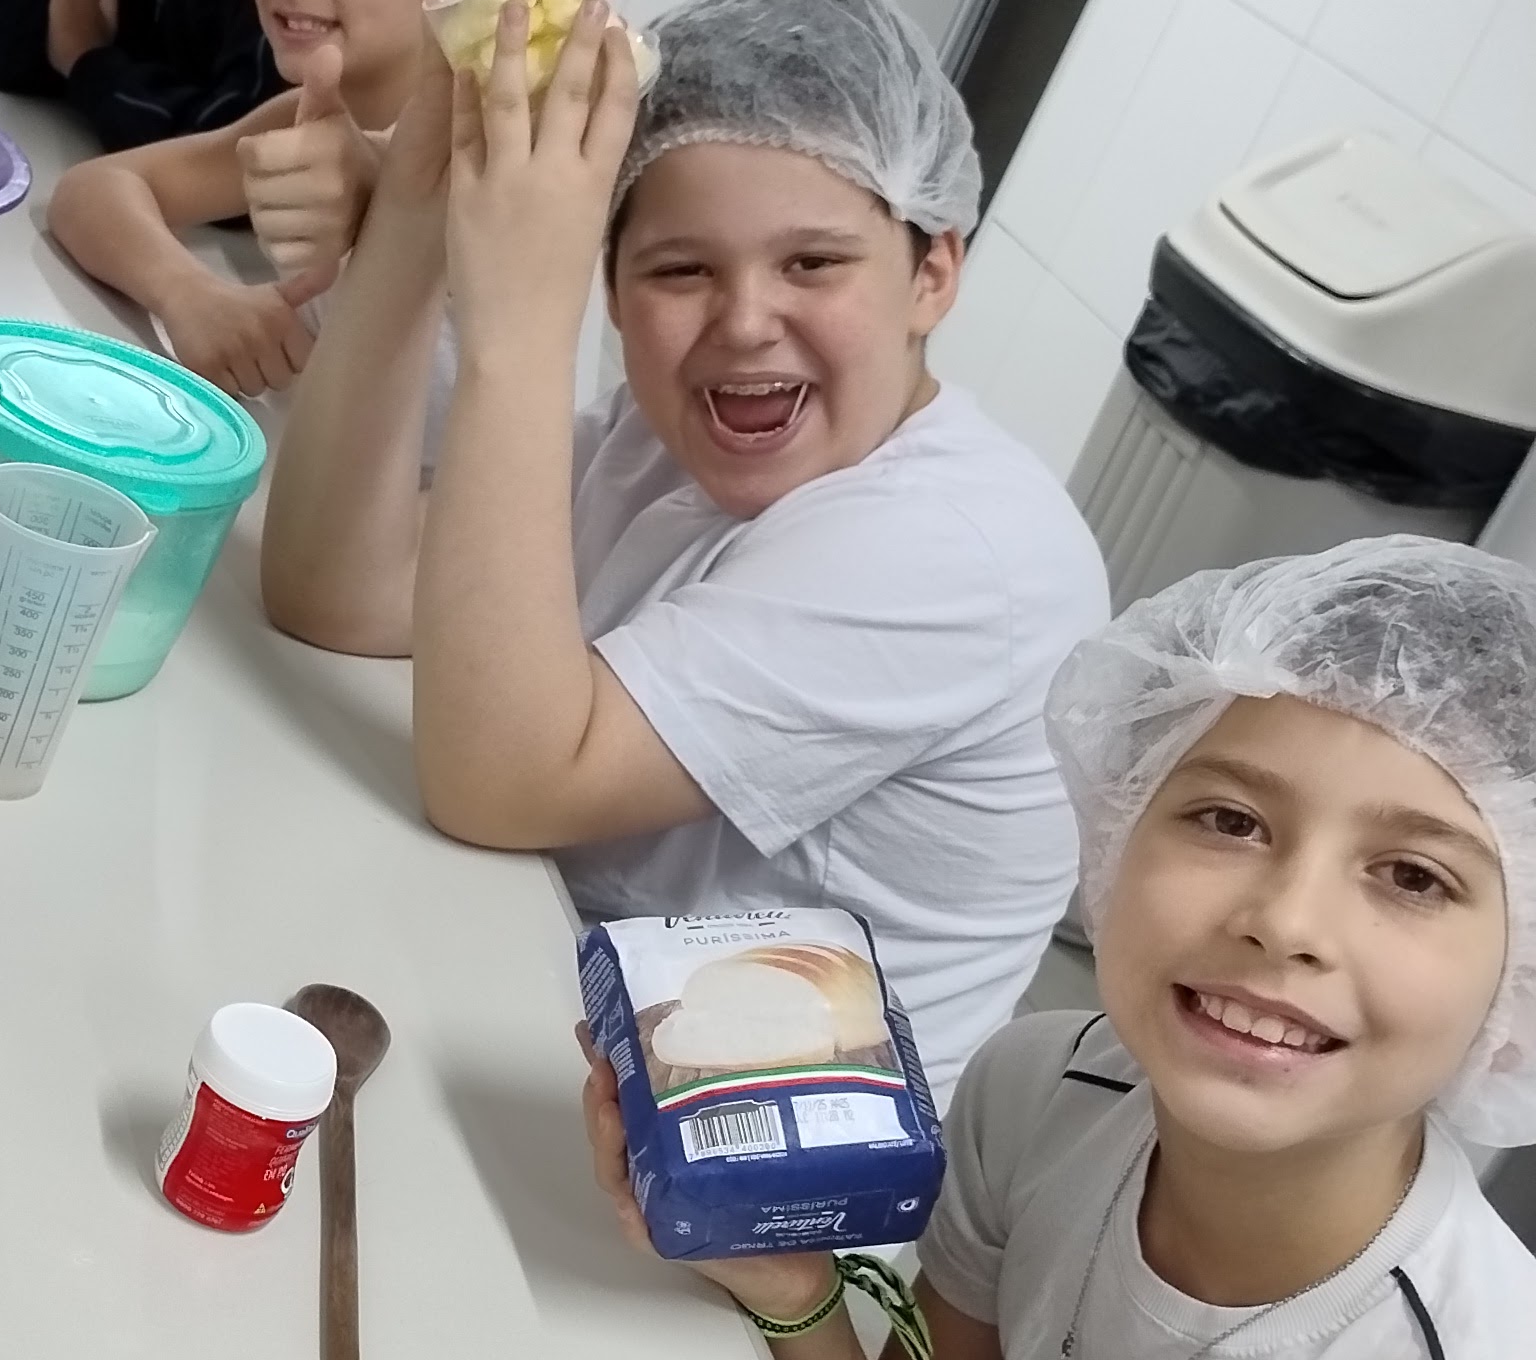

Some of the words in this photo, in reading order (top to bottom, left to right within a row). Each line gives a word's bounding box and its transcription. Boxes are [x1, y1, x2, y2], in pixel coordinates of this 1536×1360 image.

[25, 590, 46, 602] 450
[20, 609, 39, 620] 400
[13, 627, 34, 639] 350
[8, 647, 28, 659] 300
[3, 667, 21, 679] 250
